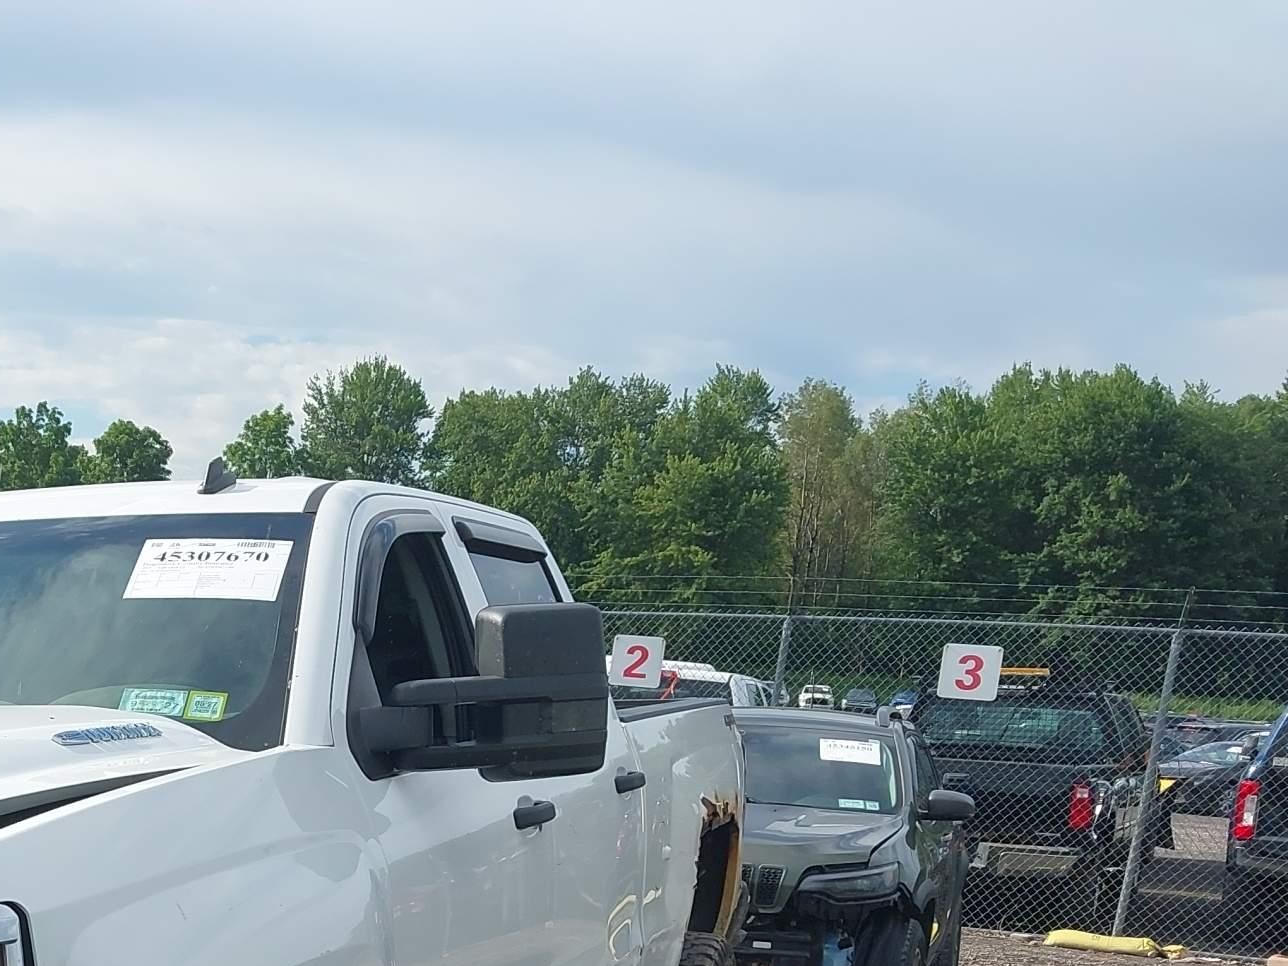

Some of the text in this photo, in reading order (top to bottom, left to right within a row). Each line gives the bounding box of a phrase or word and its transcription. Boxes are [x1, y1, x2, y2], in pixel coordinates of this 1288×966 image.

[153, 550, 270, 562] 45307670
[623, 645, 649, 679] 2
[955, 655, 984, 691] 3
